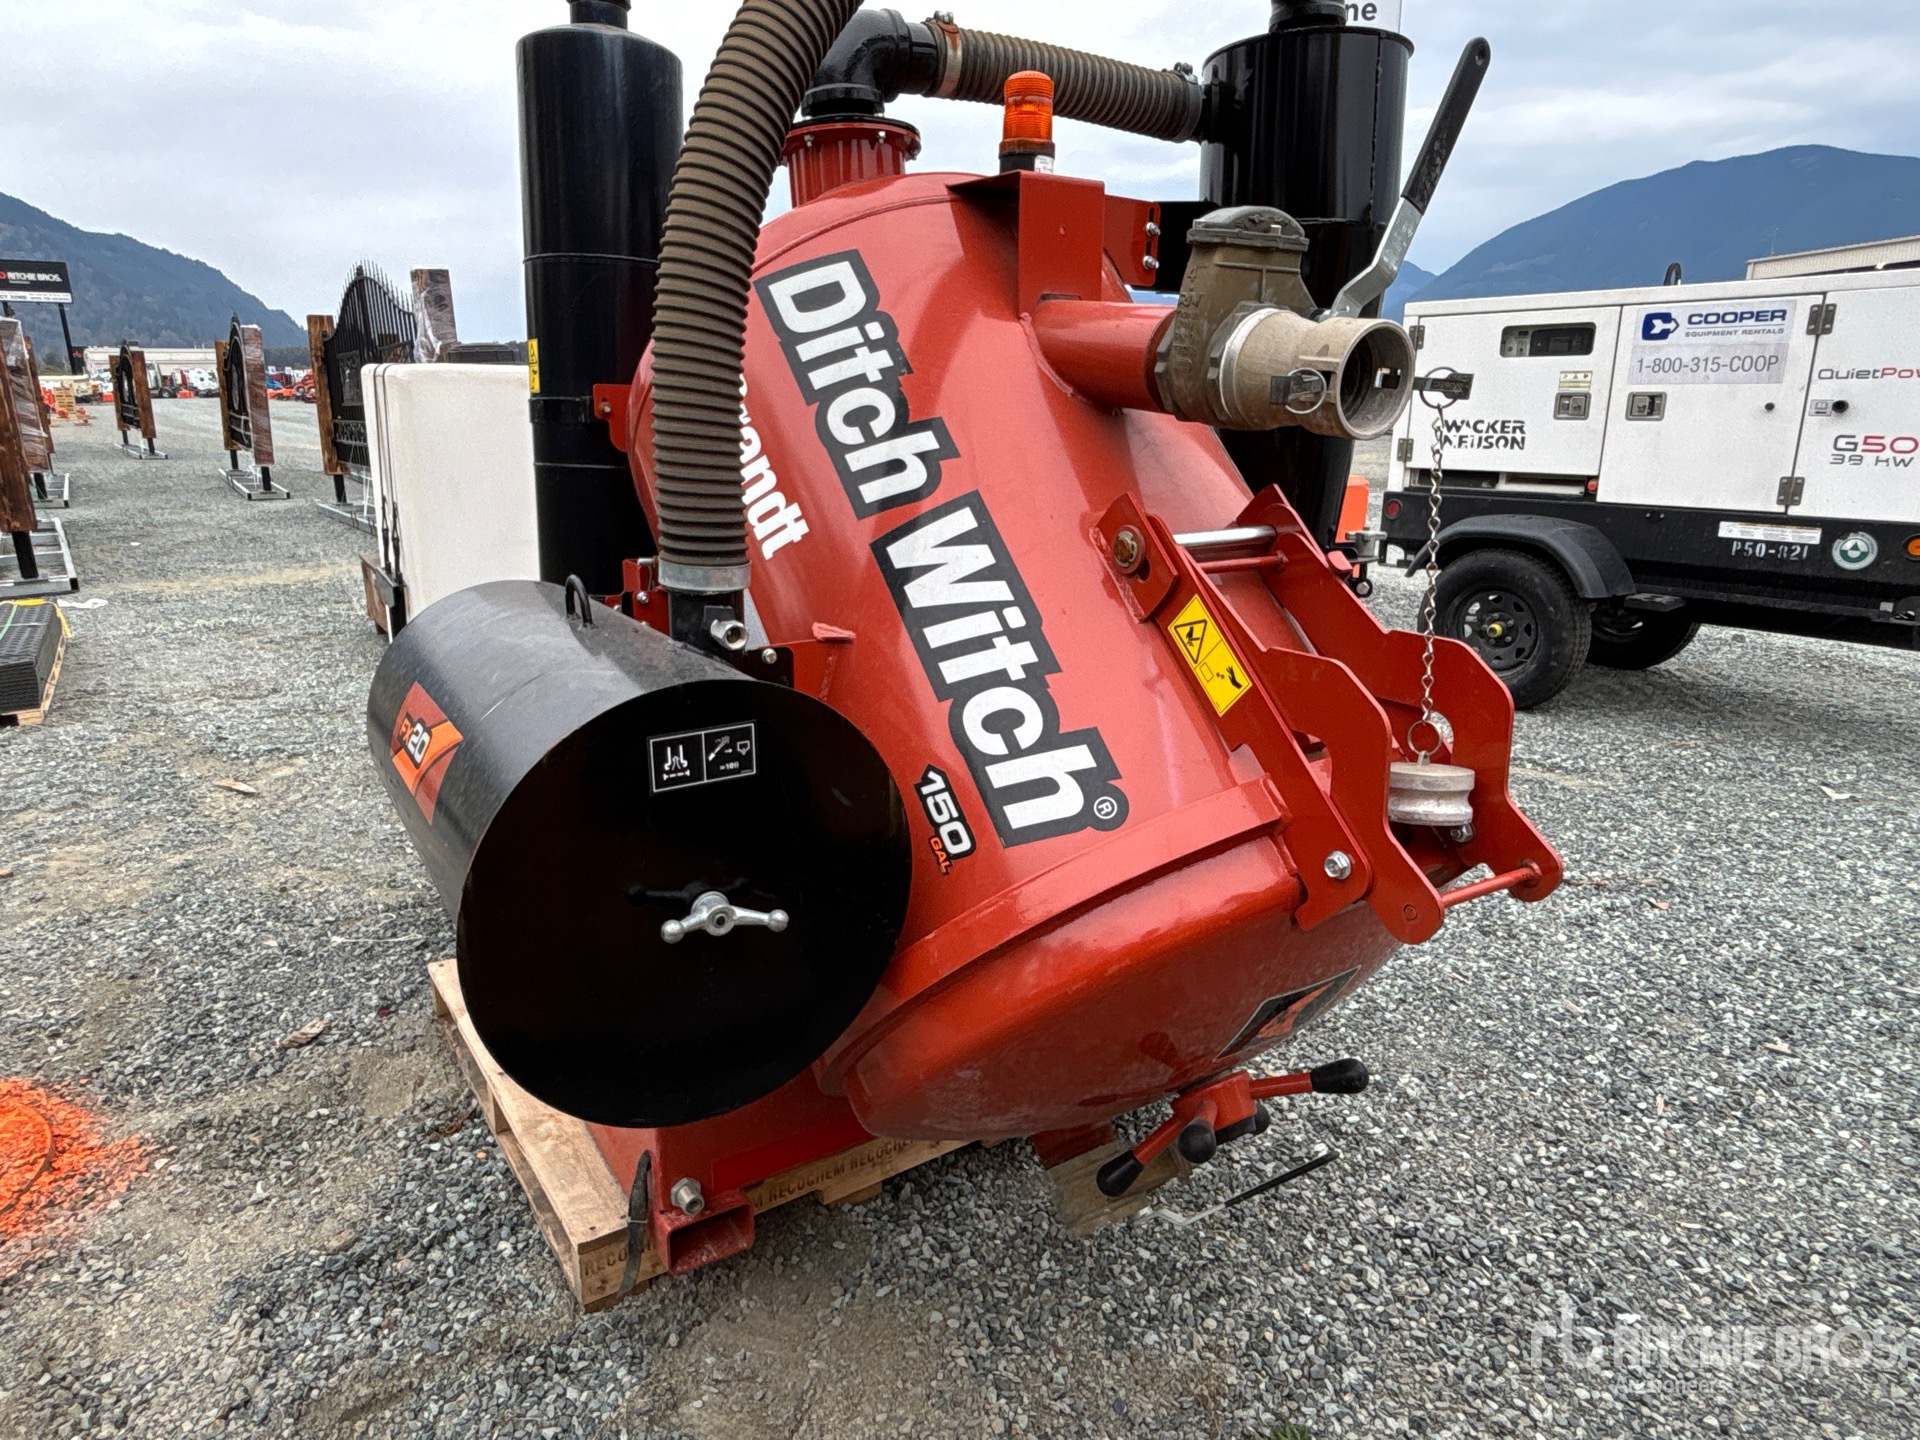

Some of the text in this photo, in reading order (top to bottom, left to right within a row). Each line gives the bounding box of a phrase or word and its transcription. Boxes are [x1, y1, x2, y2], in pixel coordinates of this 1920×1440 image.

[6, 271, 37, 282] RITCHIE
[1687, 308, 1788, 325] COOPER
[1685, 327, 1785, 338] EQUIPMENT RENTALS
[1636, 354, 1779, 374] 1-800-315-COOP
[768, 259, 941, 505] Ditch
[1832, 434, 1919, 455] G50
[920, 770, 972, 855] 150
[929, 836, 951, 874] GAL
